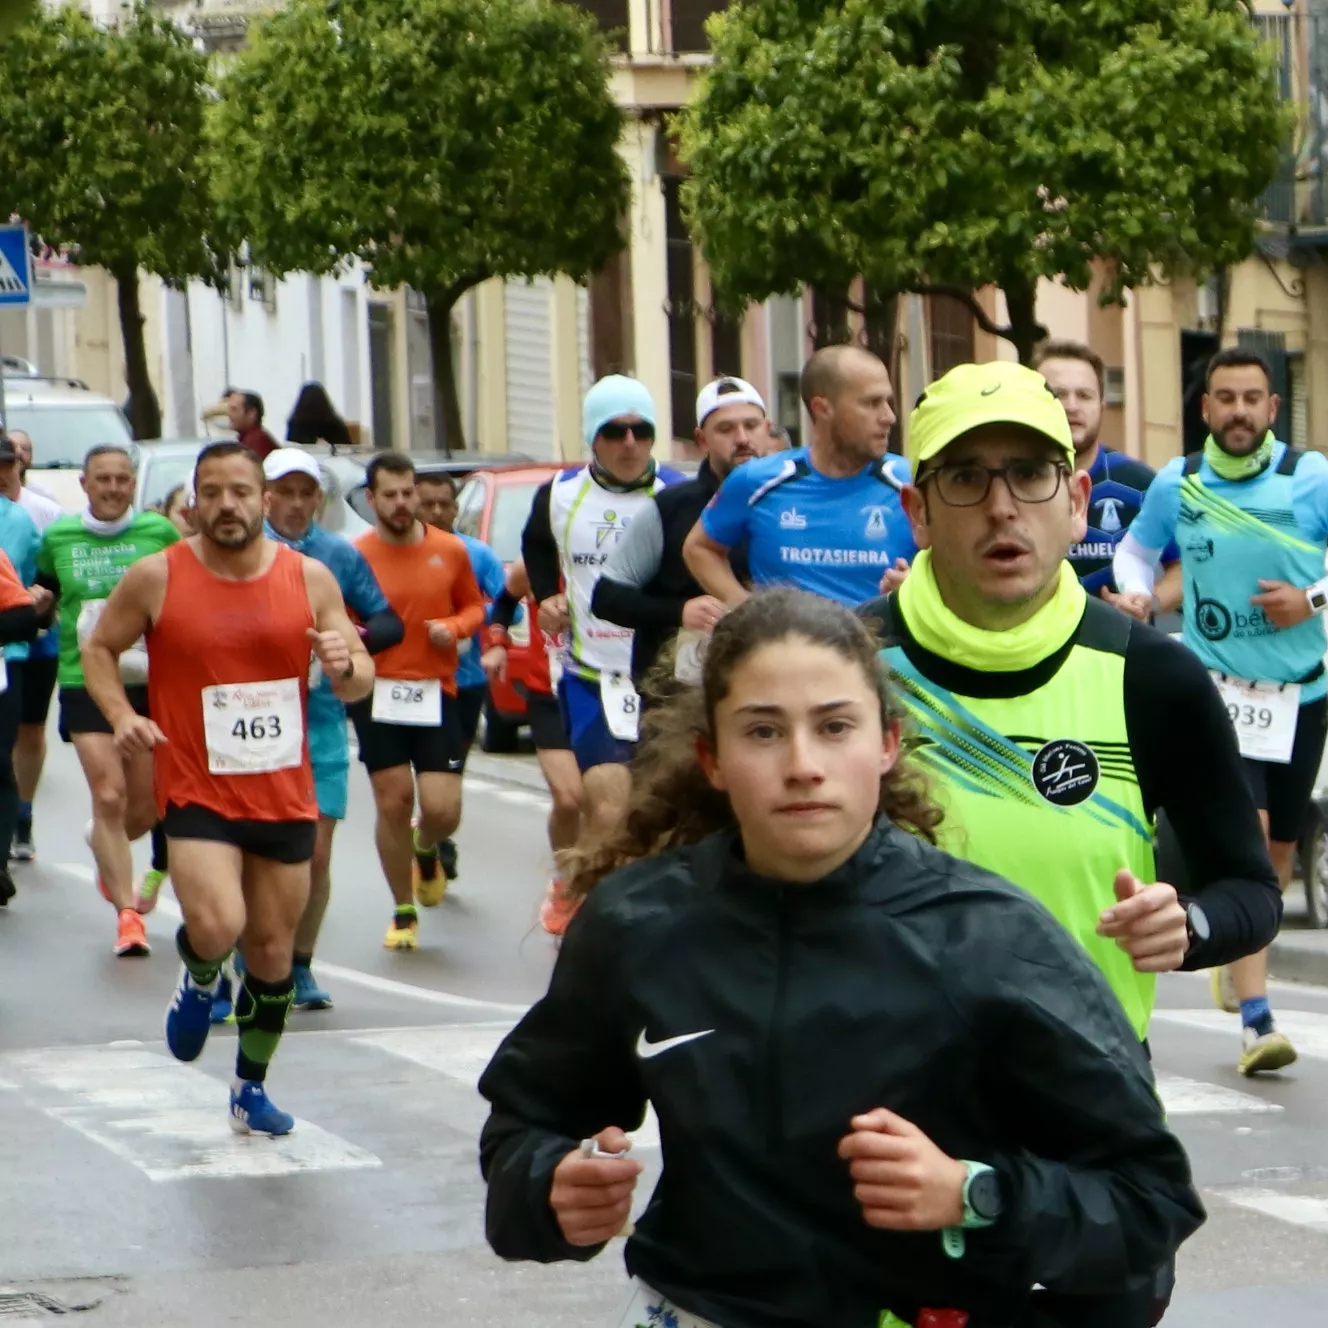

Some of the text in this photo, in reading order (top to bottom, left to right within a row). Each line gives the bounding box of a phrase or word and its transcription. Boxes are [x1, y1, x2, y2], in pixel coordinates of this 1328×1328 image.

[780, 547, 889, 565] TROTASIERRA
[391, 685, 424, 703] 678
[1226, 703, 1272, 728] 939
[231, 715, 281, 740] 463
